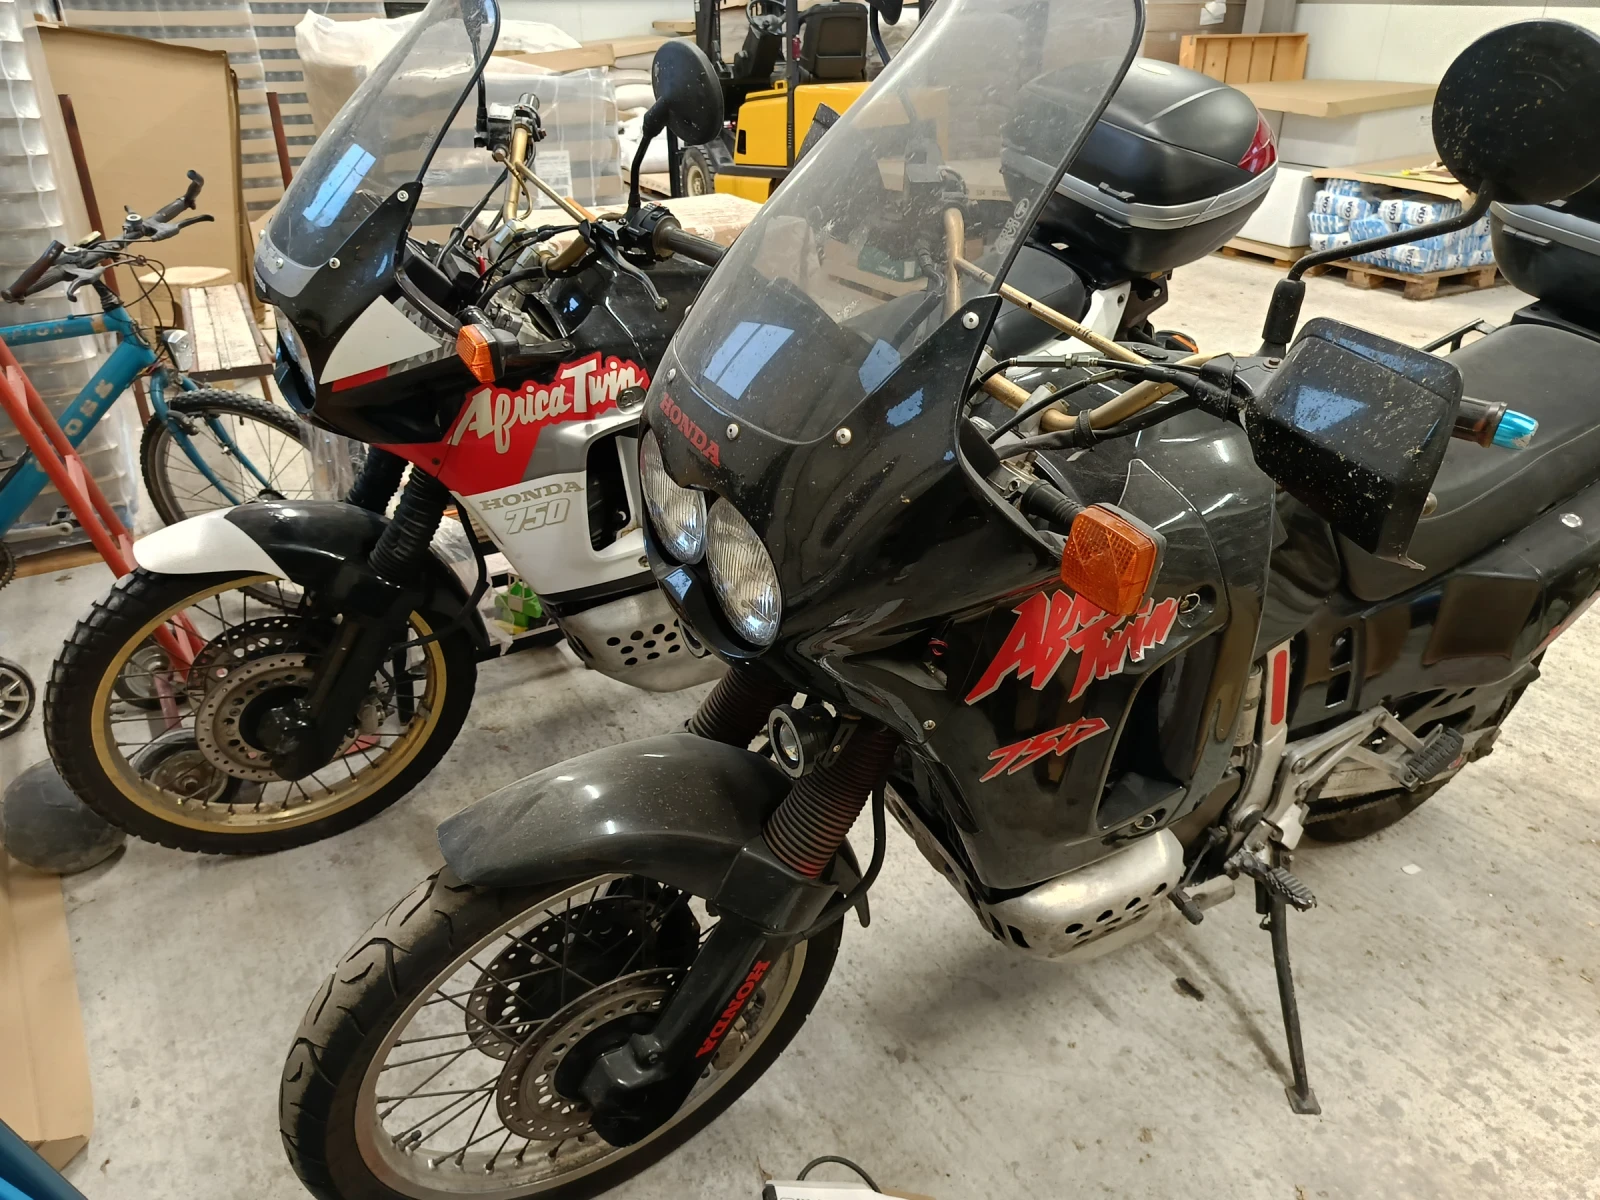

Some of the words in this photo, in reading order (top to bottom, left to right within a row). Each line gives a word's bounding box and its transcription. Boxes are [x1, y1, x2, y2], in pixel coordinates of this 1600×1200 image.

[447, 384, 572, 454] Africa
[560, 358, 643, 413] Twin
[659, 391, 721, 469] HONDA
[479, 481, 585, 511] HONDA
[504, 498, 570, 535] 750
[979, 716, 1111, 783] 750
[695, 960, 771, 1058] HONDA
